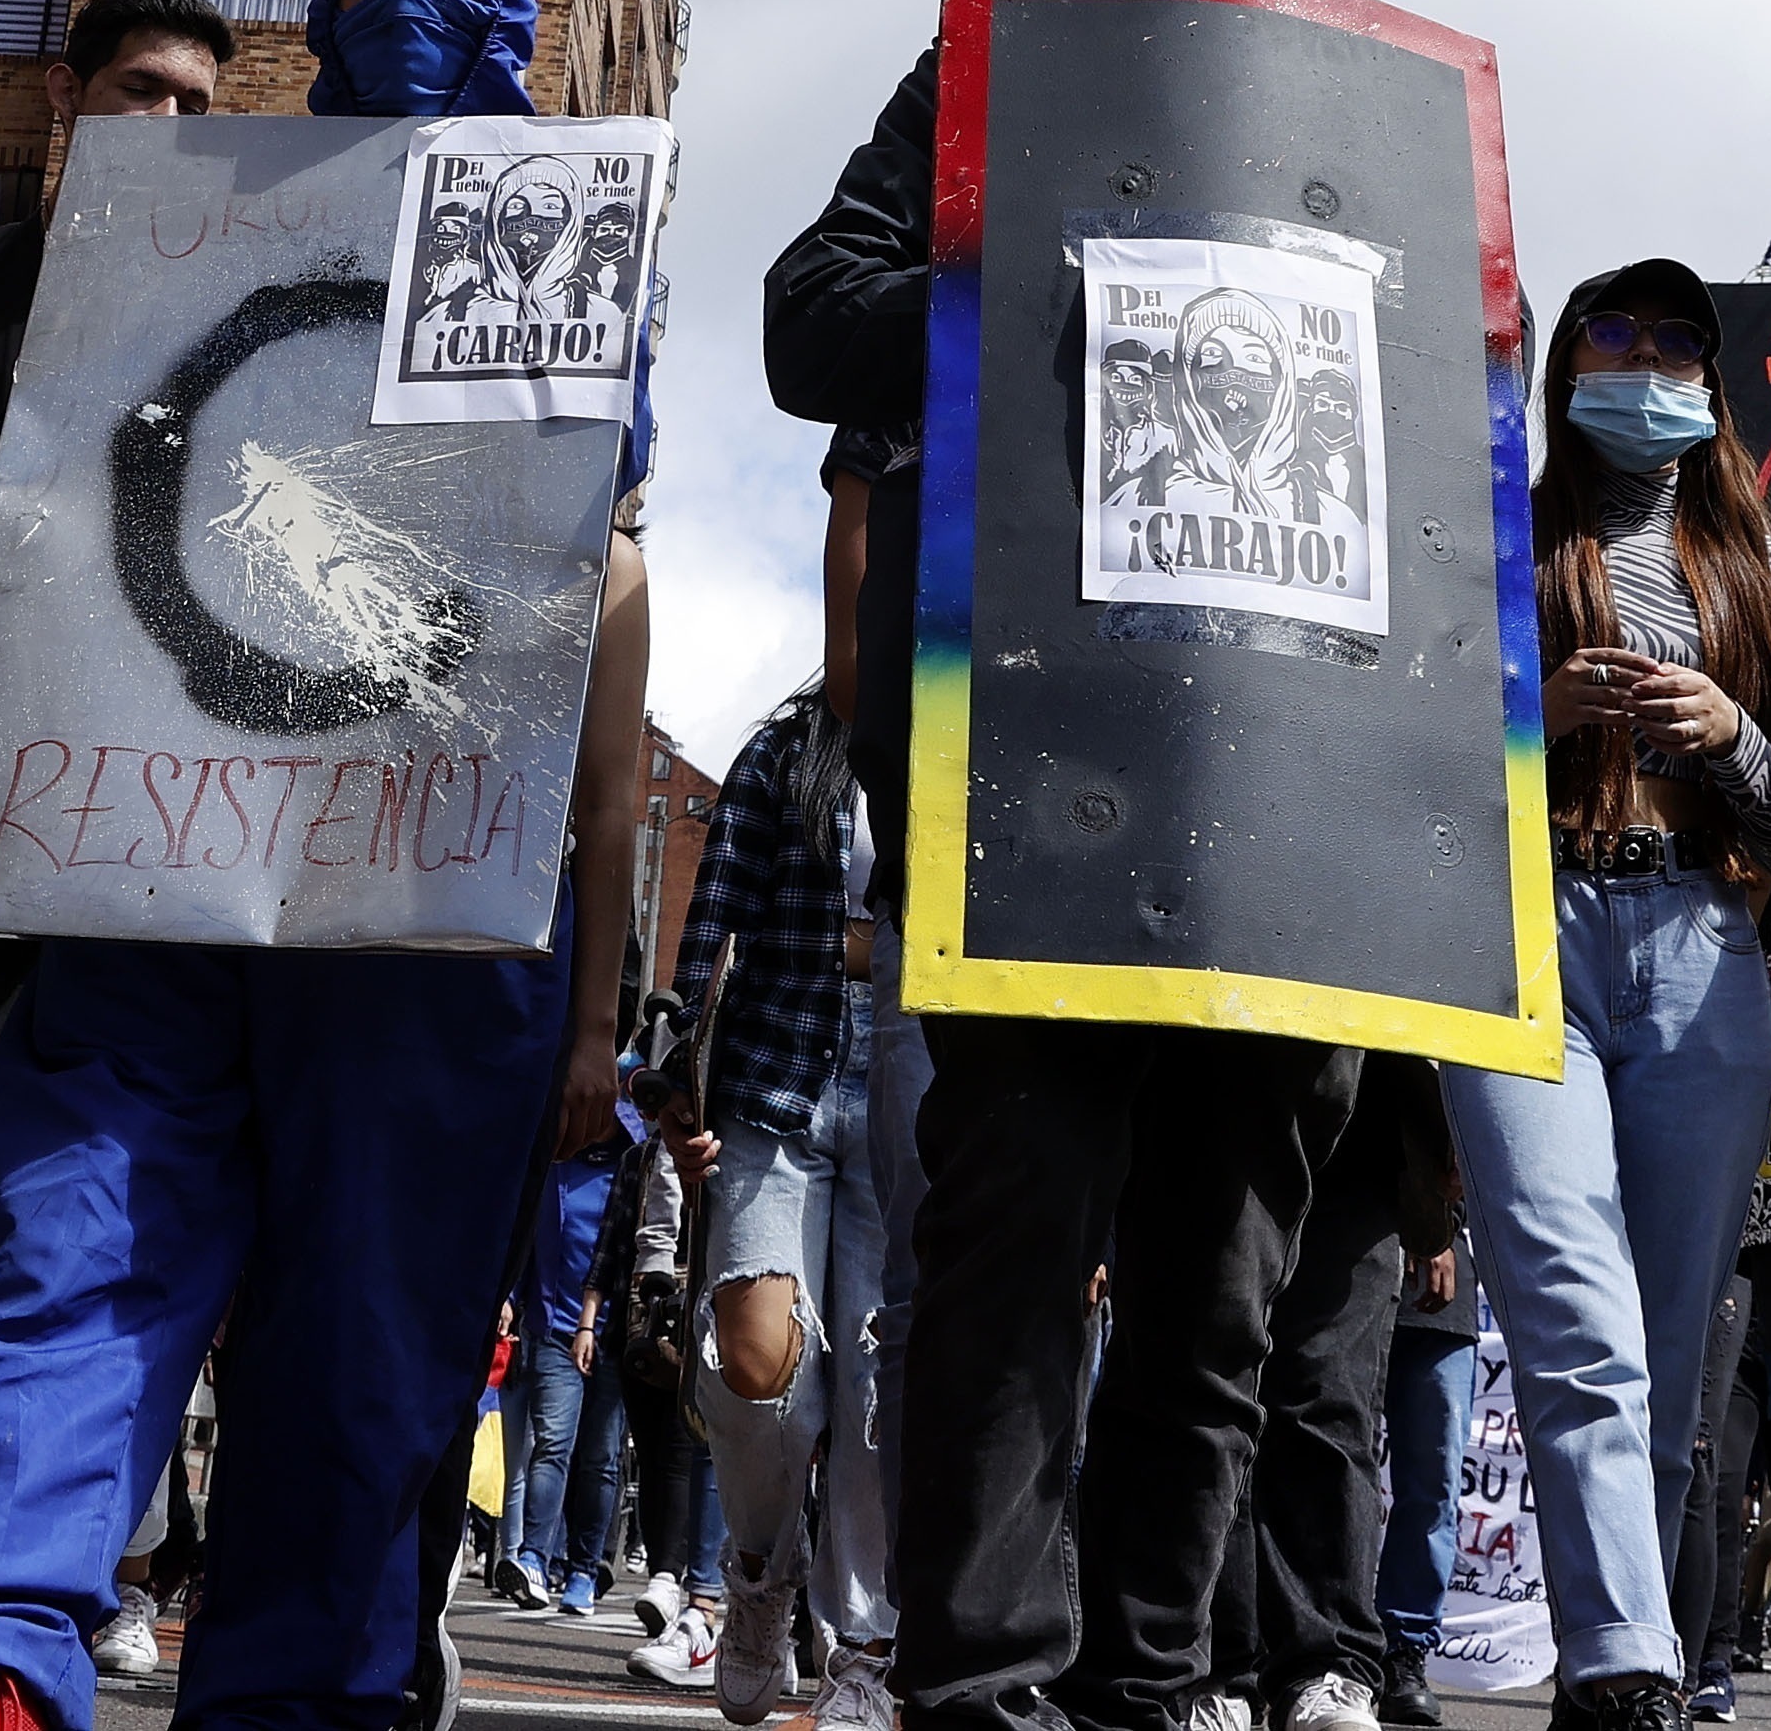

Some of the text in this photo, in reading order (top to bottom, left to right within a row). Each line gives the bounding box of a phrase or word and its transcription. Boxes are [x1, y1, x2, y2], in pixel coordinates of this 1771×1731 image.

[470, 161, 484, 176] El
[592, 157, 630, 184] NO
[586, 185, 636, 198] se rinde
[1144, 289, 1162, 307] El
[1299, 303, 1343, 346] NO
[431, 323, 607, 371] ¡CARAJO!
[1295, 341, 1353, 366] se rinde
[1128, 511, 1348, 591] ¡CARAJO!
[1479, 1409, 1526, 1456] PR
[1457, 1510, 1513, 1566] IA
